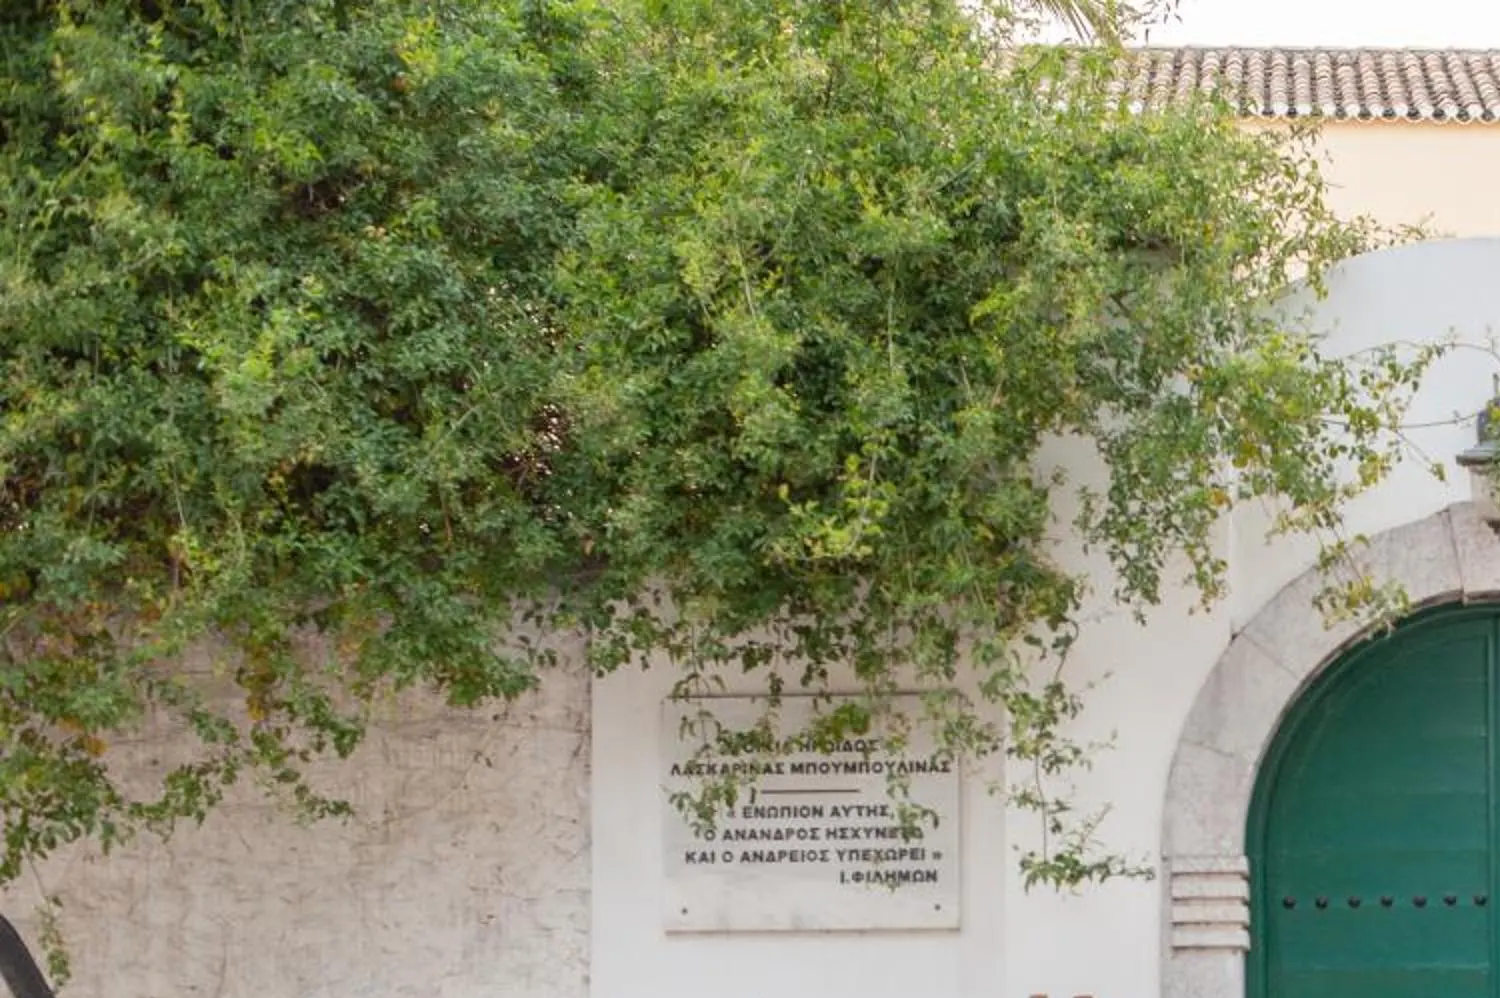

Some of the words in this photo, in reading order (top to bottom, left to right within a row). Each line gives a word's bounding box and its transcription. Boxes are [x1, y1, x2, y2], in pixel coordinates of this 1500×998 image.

[790, 760, 951, 775] ΜΠΟΥΜΠΟΥΛΙΝΑΣ
[742, 804, 824, 818] ΕΝΩΠΙΟΝ
[704, 829, 716, 841] Ο
[722, 827, 821, 841] ΑΝΑΝΔΡΟΣ
[685, 850, 716, 864] ΚΑΙ
[721, 850, 734, 863] Ο
[740, 849, 830, 863] ΑΝΔΡΕΙΟΣ
[836, 847, 926, 862] ΥΠΕΧΩΡΕΙ
